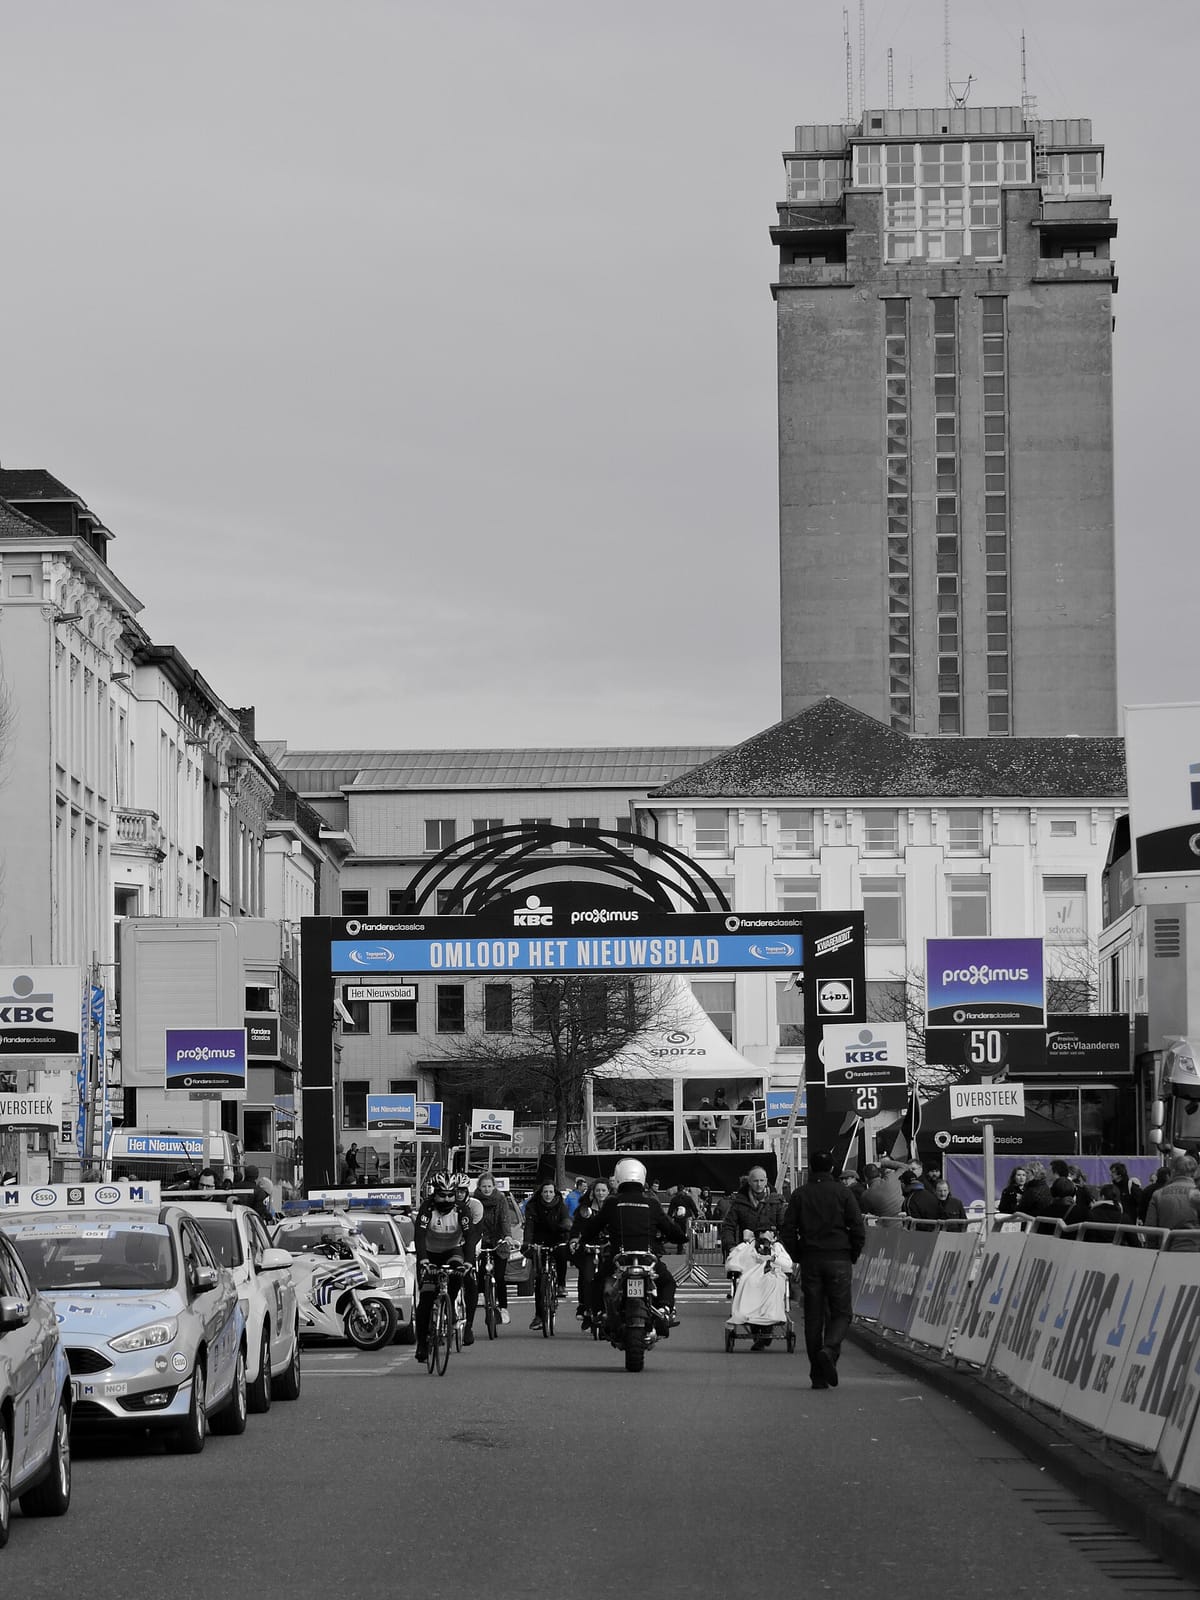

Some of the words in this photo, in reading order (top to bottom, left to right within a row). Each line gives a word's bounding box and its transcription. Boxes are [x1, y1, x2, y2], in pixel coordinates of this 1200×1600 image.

[513, 915, 553, 926] KBC
[571, 909, 639, 924] proximus
[430, 941, 520, 968] OMLOOP
[529, 940, 568, 967] HET
[576, 938, 720, 966] NIEUWSBLAD
[942, 965, 1030, 986] proximus
[351, 988, 364, 998] Het
[366, 987, 412, 998] Nieuwsblad
[0, 1006, 54, 1023] KBC
[650, 1046, 707, 1057] sporza
[971, 1030, 1001, 1063] 50
[1052, 1041, 1120, 1050] Oost-Vlaanderen
[176, 1047, 236, 1062] proximus
[845, 1050, 888, 1063] KBC
[856, 1087, 878, 1110] 25
[956, 1091, 1018, 1107] OVERSTEEK
[0, 1100, 53, 1115] VERSTEEK
[480, 1123, 503, 1131] KBC
[129, 1139, 147, 1150] Het
[1053, 1270, 1120, 1391] KBC
